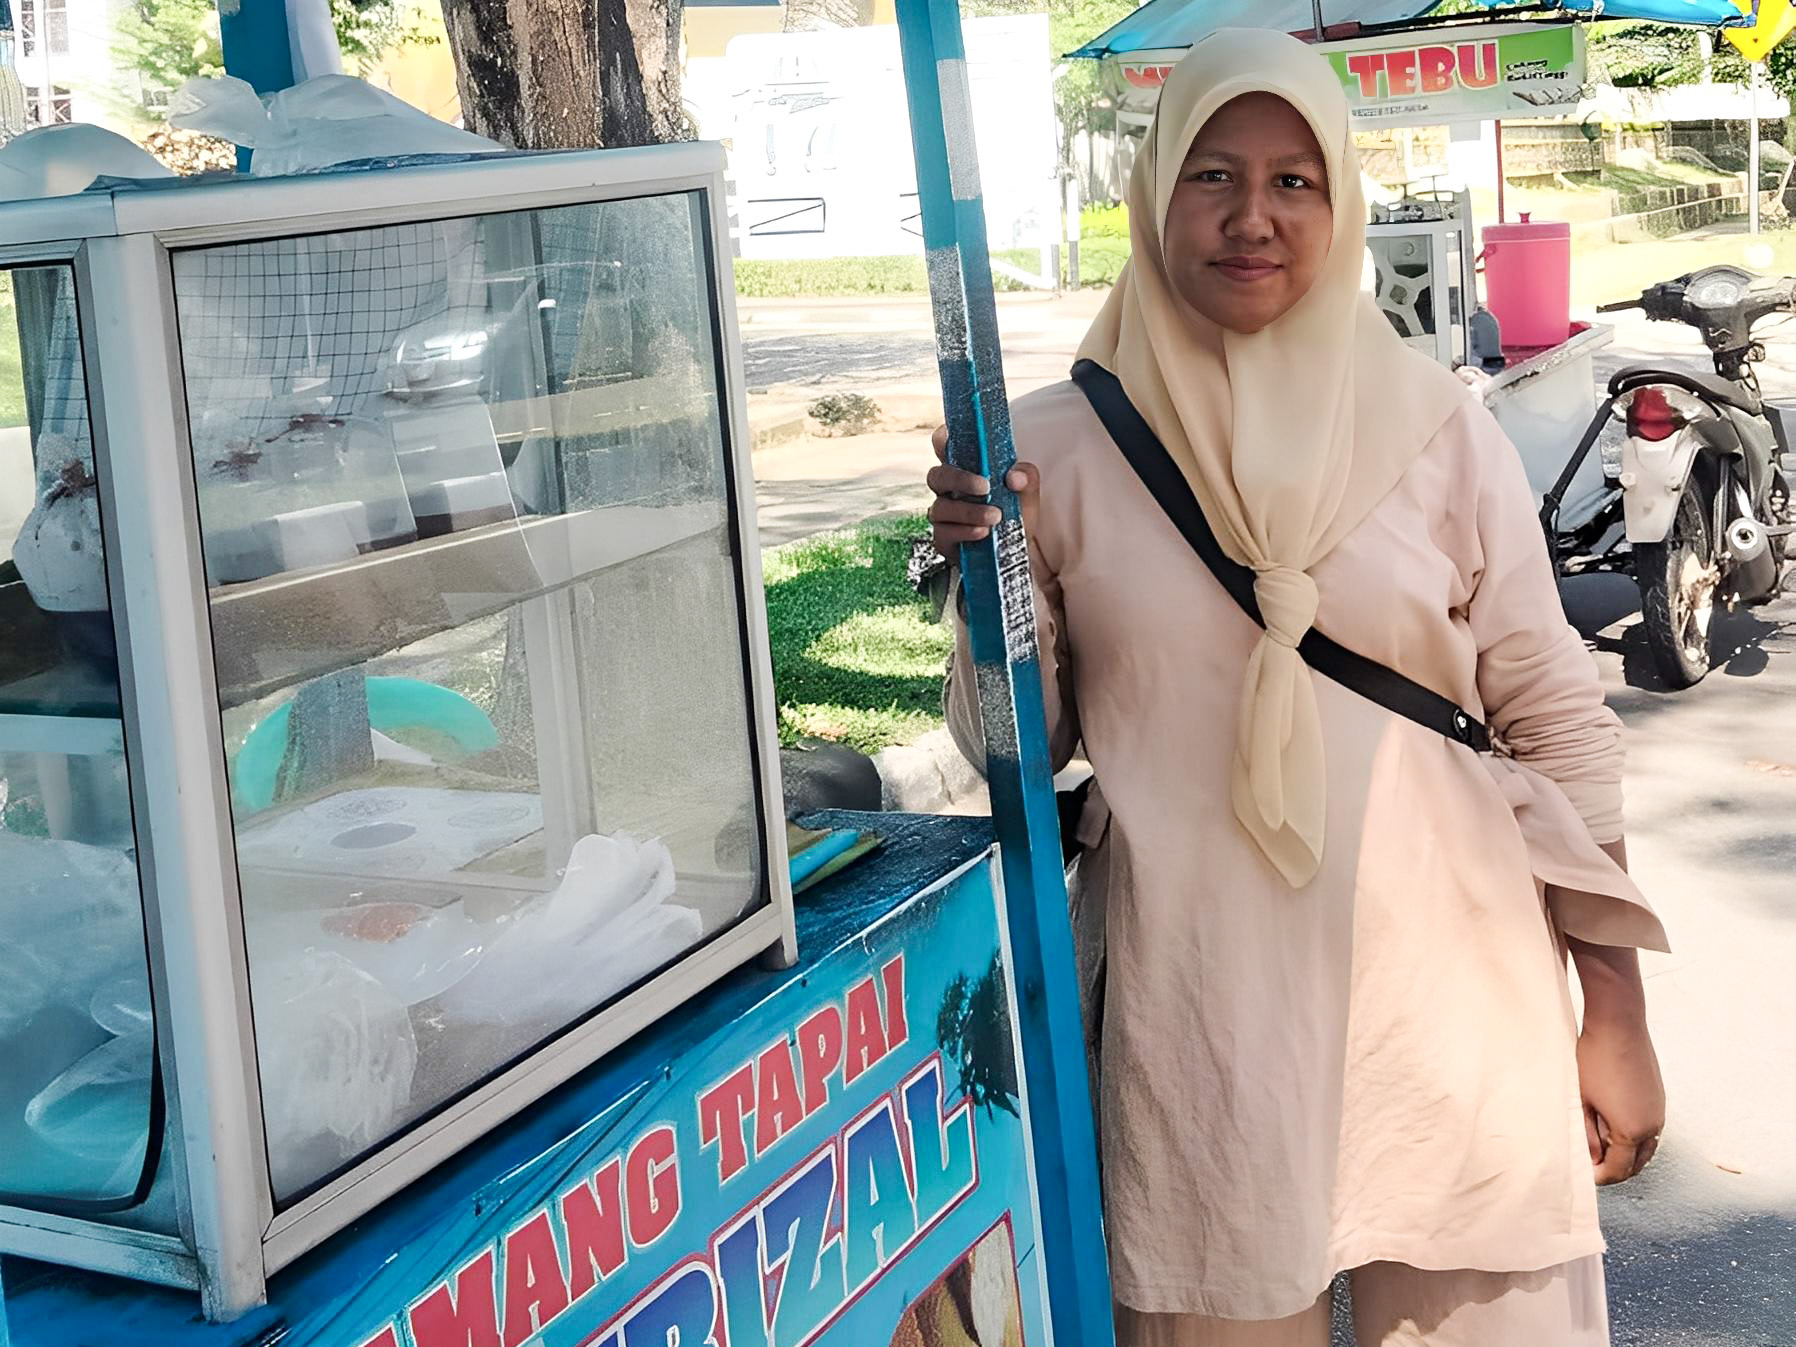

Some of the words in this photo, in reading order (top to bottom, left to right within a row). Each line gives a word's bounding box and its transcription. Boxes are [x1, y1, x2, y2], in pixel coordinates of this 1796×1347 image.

[1347, 41, 1498, 99] TEBU
[357, 1122, 682, 1347] MANG
[699, 953, 909, 1185] TAPAI
